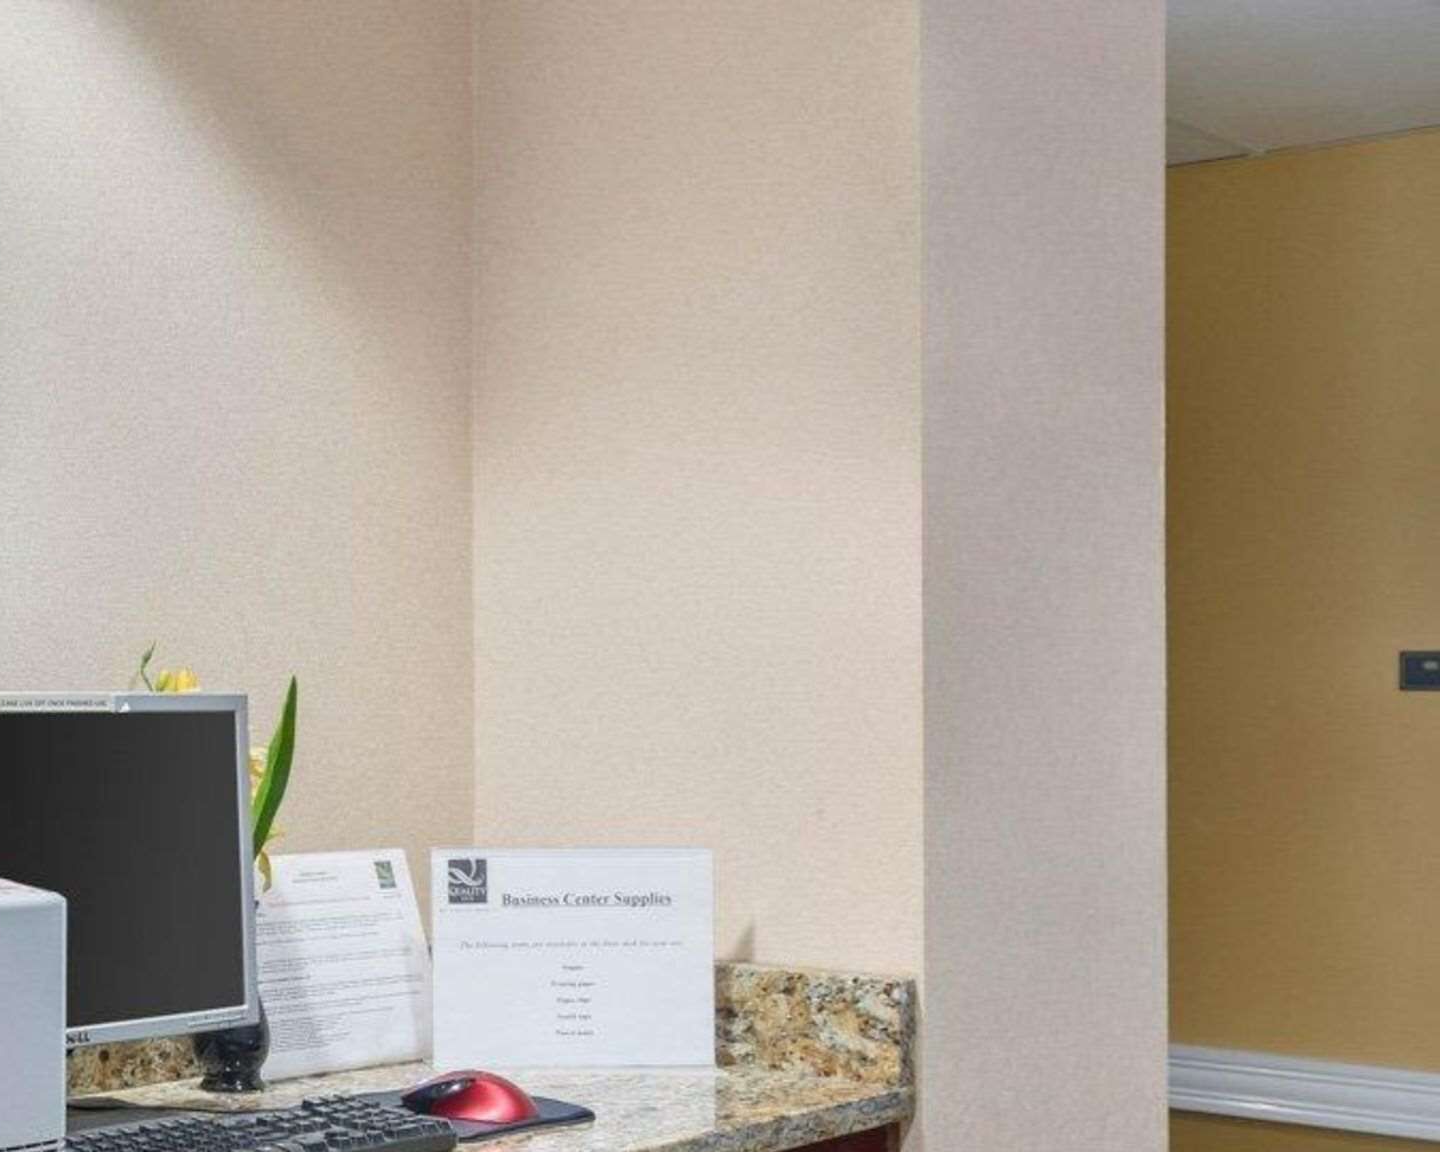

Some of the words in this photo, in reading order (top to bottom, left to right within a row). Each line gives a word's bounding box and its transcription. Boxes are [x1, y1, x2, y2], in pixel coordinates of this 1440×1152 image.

[502, 892, 560, 908] Business
[562, 891, 610, 908] Center
[612, 890, 673, 908] Supplies
